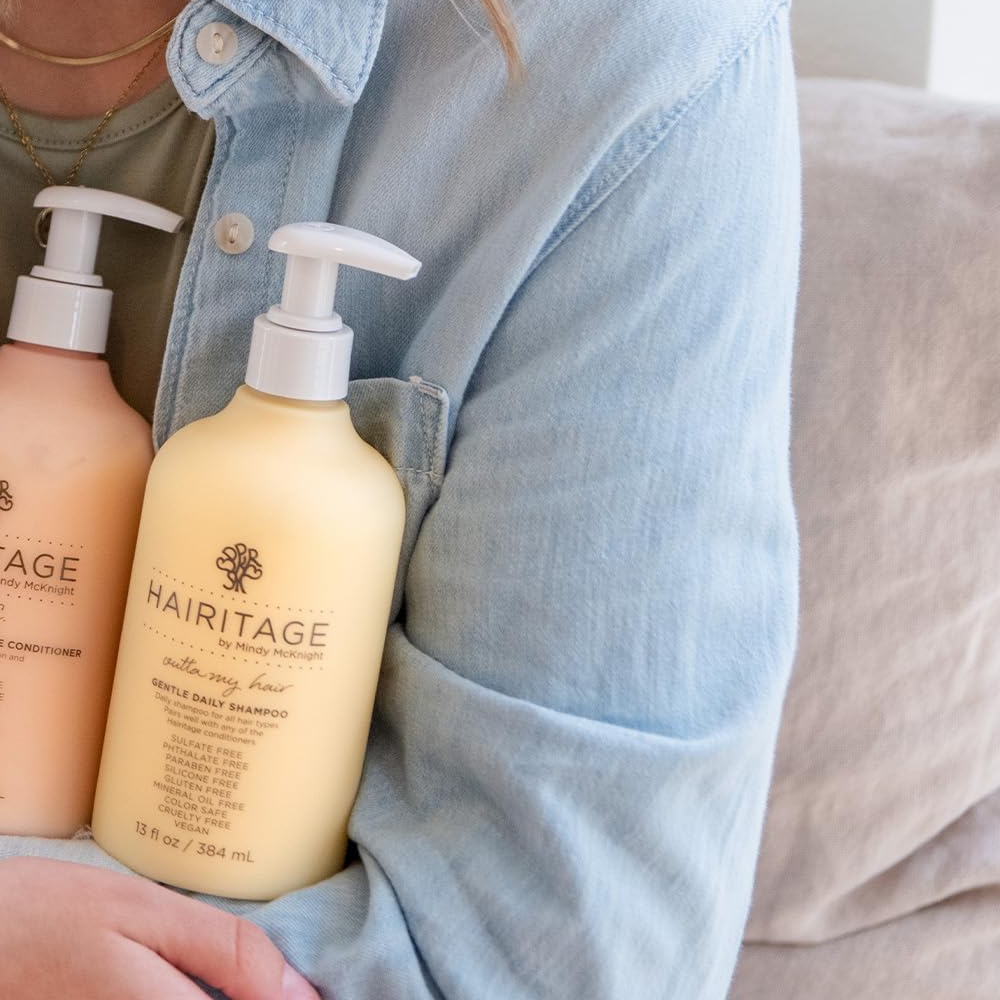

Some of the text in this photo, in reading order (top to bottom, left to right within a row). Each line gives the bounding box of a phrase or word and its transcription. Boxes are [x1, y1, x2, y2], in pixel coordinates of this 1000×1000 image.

[24, 580, 75, 597] McKnight
[147, 579, 330, 647] HAIRITAGE
[7, 640, 82, 658] CONDITIONER
[8, 652, 25, 662] and
[218, 637, 324, 661] by Mindy McKnight
[162, 655, 294, 698] outta my hair
[151, 677, 289, 719] GENTLE DAILY SHAMPOO
[154, 692, 279, 730] Daily shampoo for all hair types
[164, 706, 264, 737] Pairs well with any of the
[167, 717, 256, 746] Hairitage conditioners
[163, 742, 248, 771] PHTHALATE FREE
[171, 734, 243, 759] SULFATE FREE
[165, 764, 239, 790] SILICONE FREE
[166, 753, 241, 780] PARABEN FREE
[153, 780, 245, 811] MINERAL OIL FREE
[164, 775, 232, 799] GLUTEN FREE
[158, 804, 231, 830] CRUELTY FREE
[164, 795, 228, 818] COLOR SAFE
[174, 820, 210, 836] VEGAN
[135, 821, 254, 863] 13 fl oz / 384 mL
